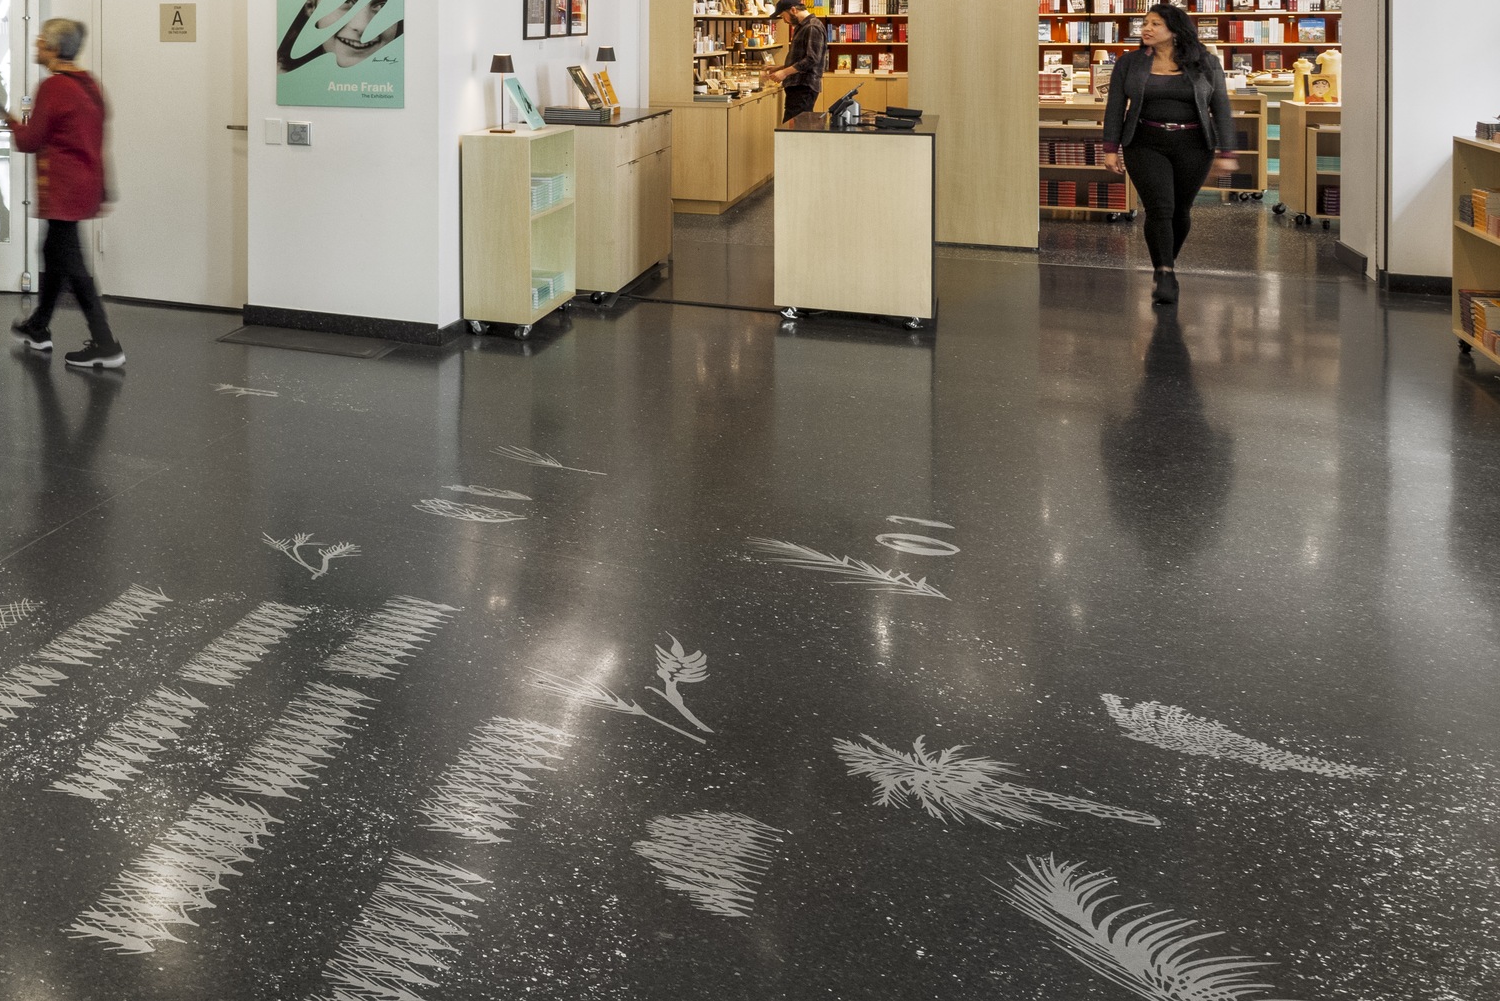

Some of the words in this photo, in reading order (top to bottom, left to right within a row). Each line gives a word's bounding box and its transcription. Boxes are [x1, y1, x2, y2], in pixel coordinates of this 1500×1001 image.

[172, 10, 184, 26] A
[328, 82, 358, 92] Anne
[361, 82, 394, 92] Frank
